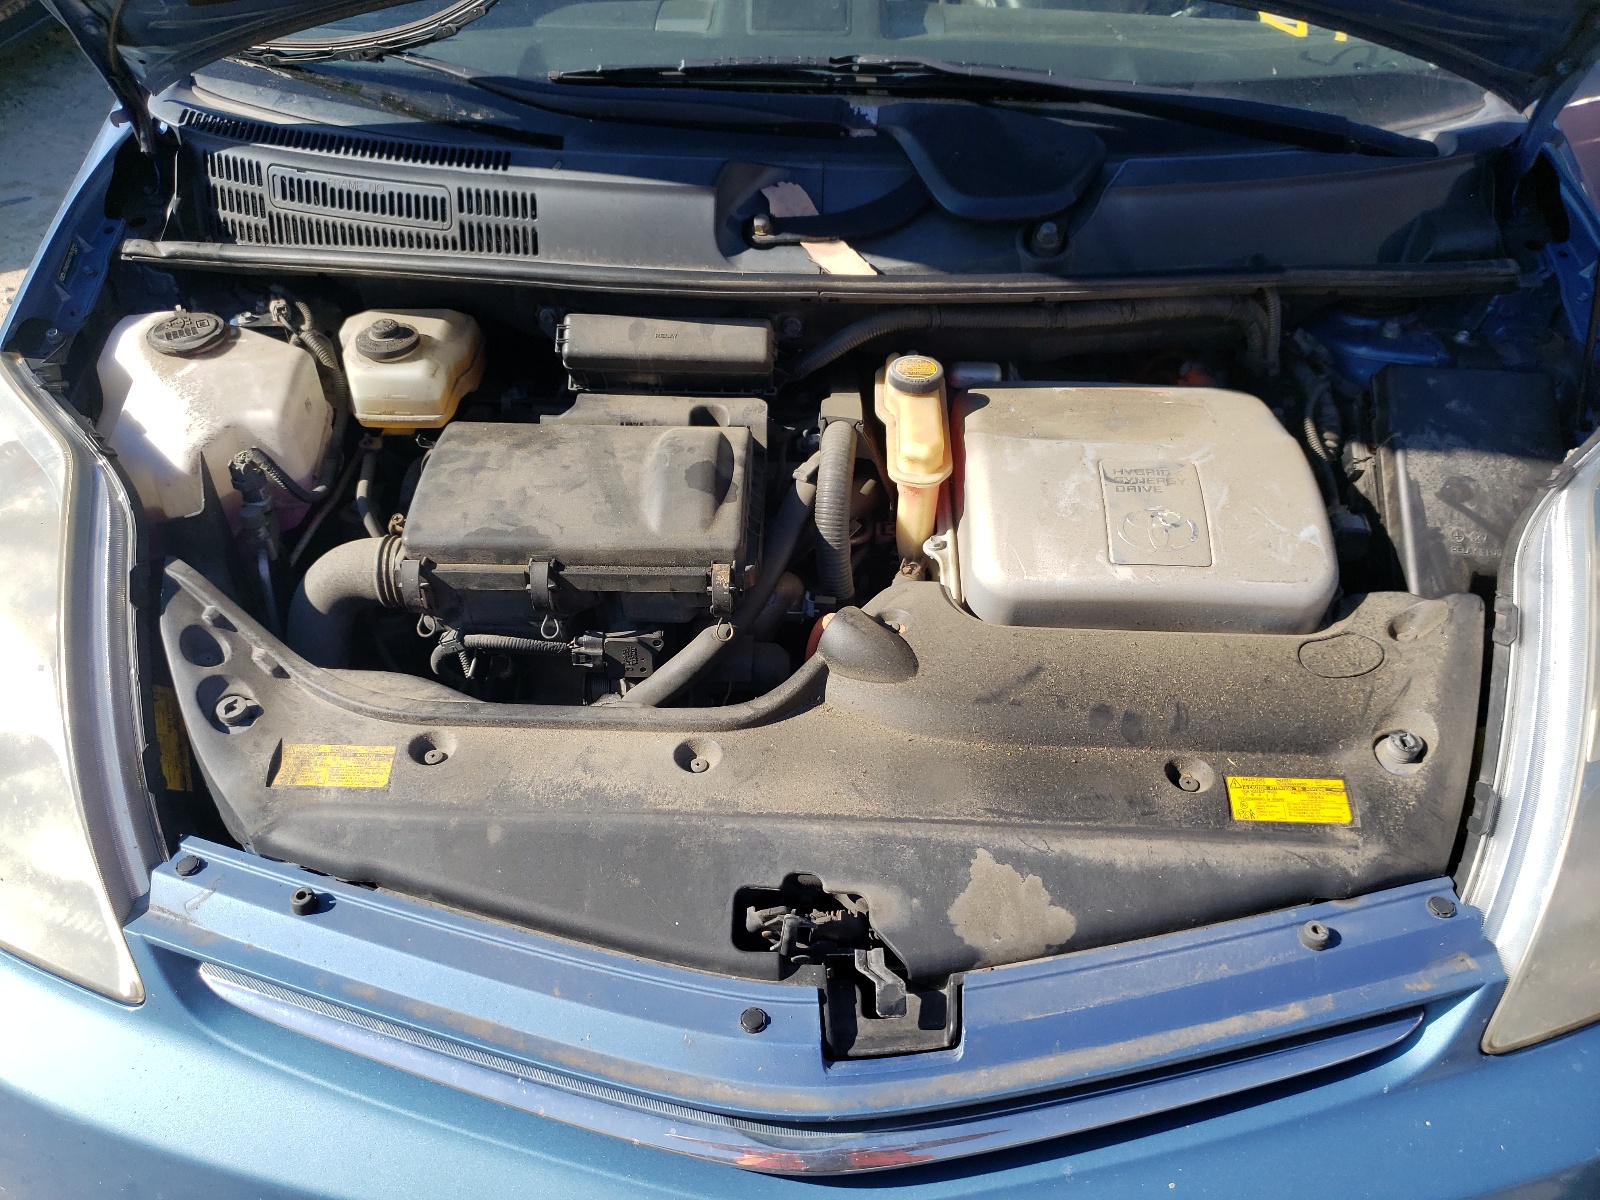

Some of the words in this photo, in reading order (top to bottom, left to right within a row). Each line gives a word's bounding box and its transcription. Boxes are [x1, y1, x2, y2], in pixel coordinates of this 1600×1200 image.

[328, 178, 363, 191] FRAME
[1113, 468, 1171, 476] HYBRID
[1113, 476, 1187, 486] SYNERGY
[1115, 485, 1164, 493] DRIVE
